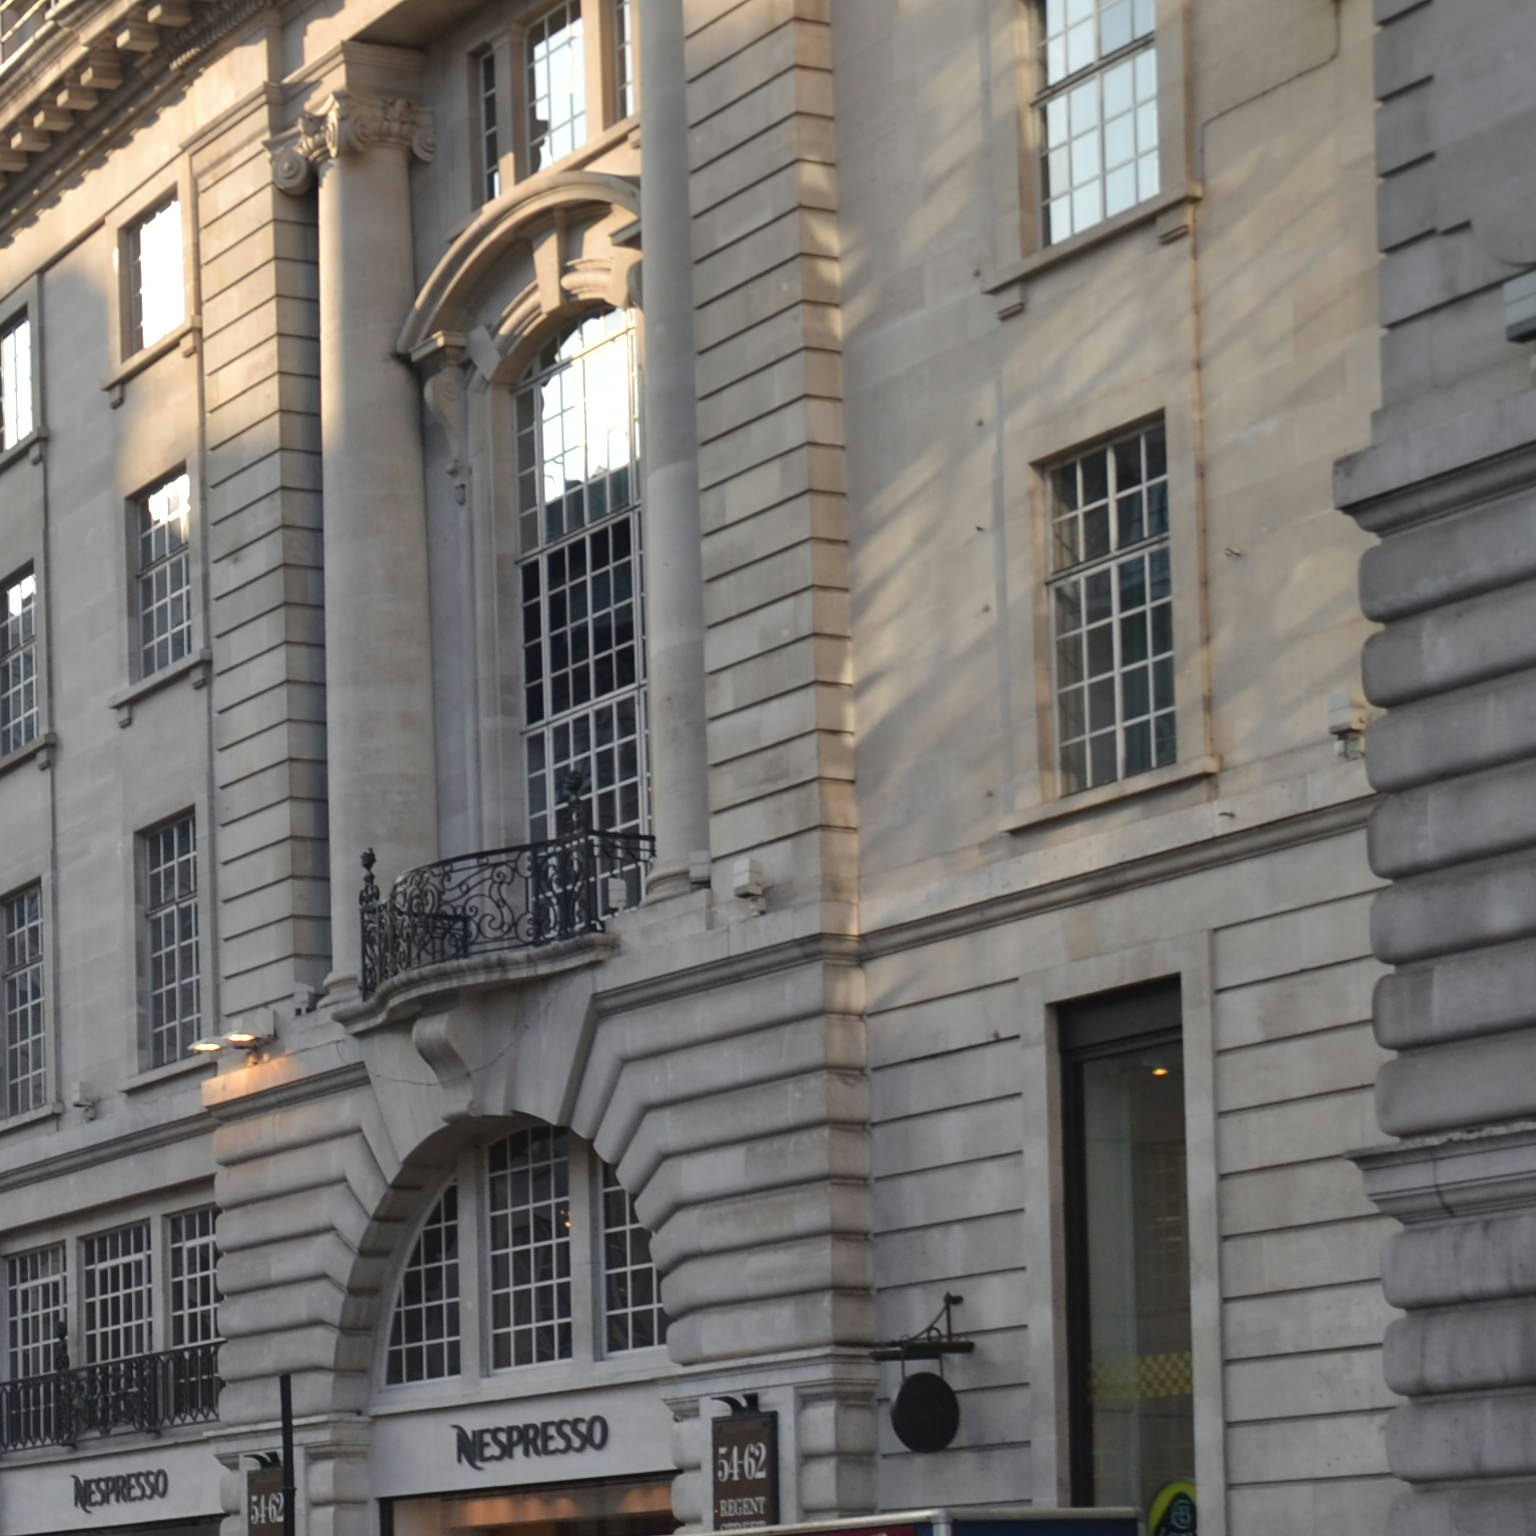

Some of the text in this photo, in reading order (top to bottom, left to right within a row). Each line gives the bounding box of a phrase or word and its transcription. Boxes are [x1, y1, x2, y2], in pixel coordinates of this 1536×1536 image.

[450, 1415, 609, 1471] NESPRESSO
[718, 1442, 767, 1482] 54-62
[70, 1468, 169, 1514] NESPRESSO
[251, 1492, 285, 1524] 54-62
[720, 1497, 766, 1517] REGENT
